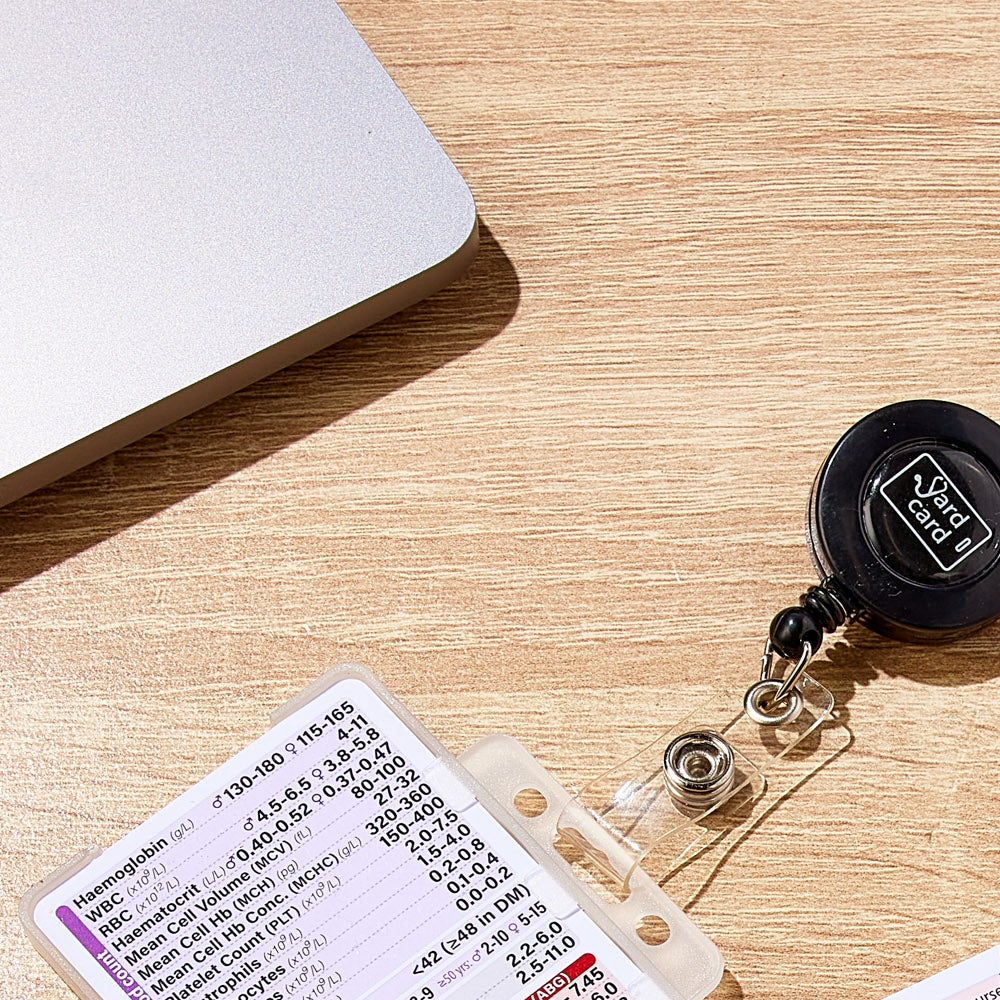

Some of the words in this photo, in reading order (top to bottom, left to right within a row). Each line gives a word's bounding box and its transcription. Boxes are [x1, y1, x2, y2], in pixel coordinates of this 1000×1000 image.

[908, 499, 952, 544] card
[72, 838, 169, 910] Haemoglobin
[170, 819, 195, 842] (g/L)
[223, 752, 285, 800] 130-180
[296, 700, 354, 746] 115-165
[404, 809, 459, 854] 2.0-7.5
[124, 933, 168, 967] Mean
[166, 908, 198, 935] Cell
[194, 871, 251, 912] Volume
[250, 840, 293, 875] (MCV)
[294, 826, 312, 845] (fL)
[350, 755, 406, 799] 80-100
[455, 866, 514, 911] 0.0-0.2
[412, 950, 443, 975] <42
[475, 911, 496, 927] in
[493, 883, 531, 914] DM)
[506, 921, 563, 968] 2.2-6.0
[96, 949, 135, 987] count
[568, 966, 604, 997] 7.45
